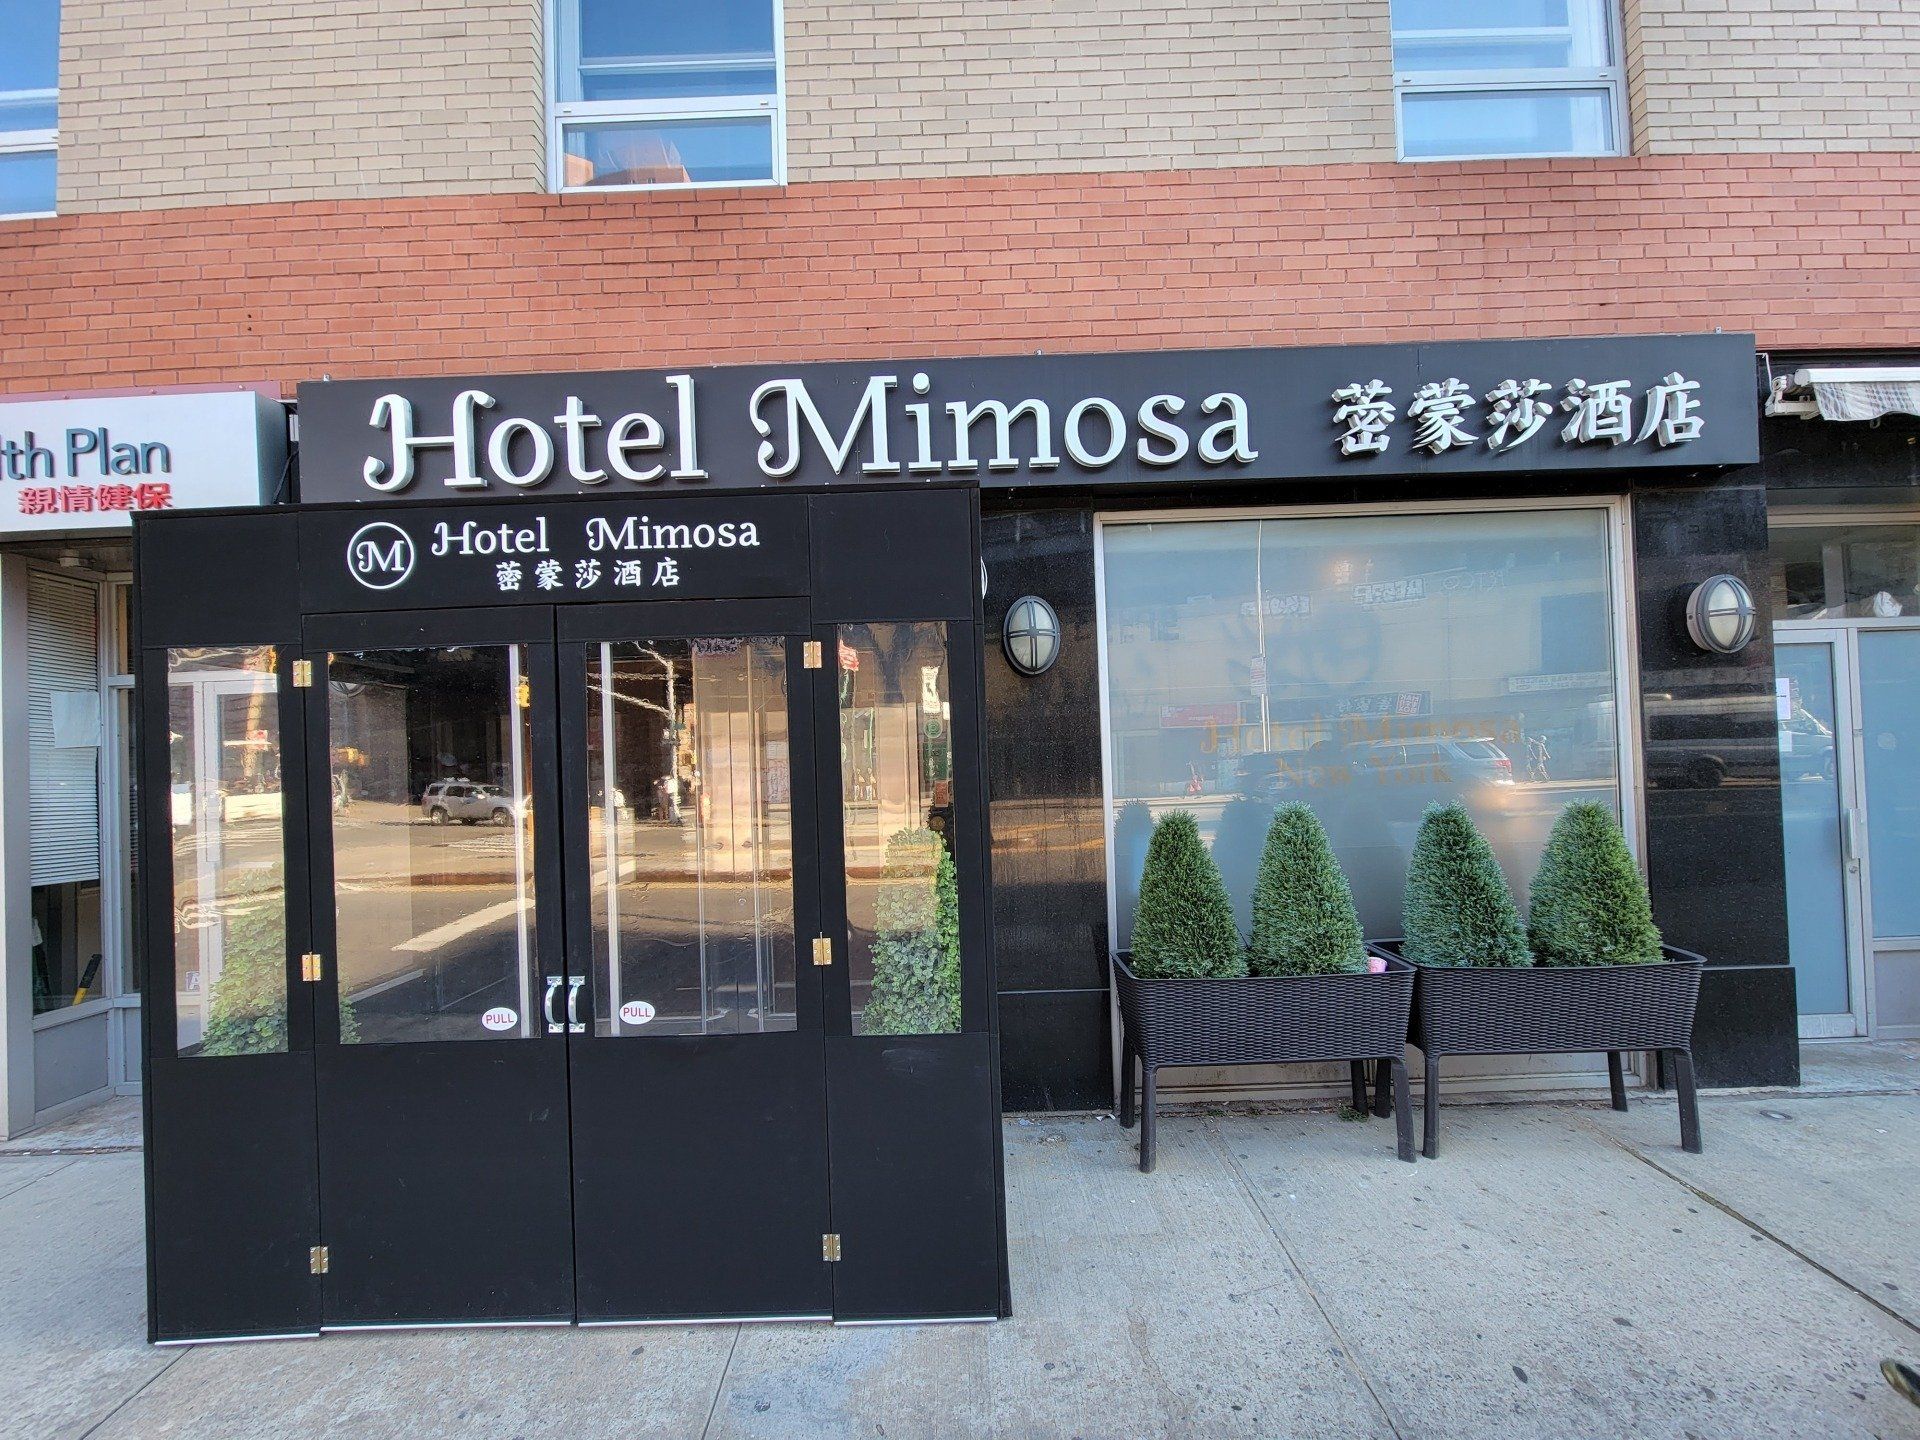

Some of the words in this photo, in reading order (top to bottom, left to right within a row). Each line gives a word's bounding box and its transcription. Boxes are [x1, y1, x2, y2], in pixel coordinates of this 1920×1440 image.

[363, 374, 708, 493] Hotel
[750, 372, 1258, 478] Mimosa
[0, 430, 55, 480] th
[66, 427, 172, 477] Plan
[18, 483, 173, 514] 親情健保
[431, 516, 550, 557] Hotel
[585, 514, 761, 553] Mimosa
[486, 1014, 514, 1024] PULL
[623, 1007, 651, 1018] PULL
